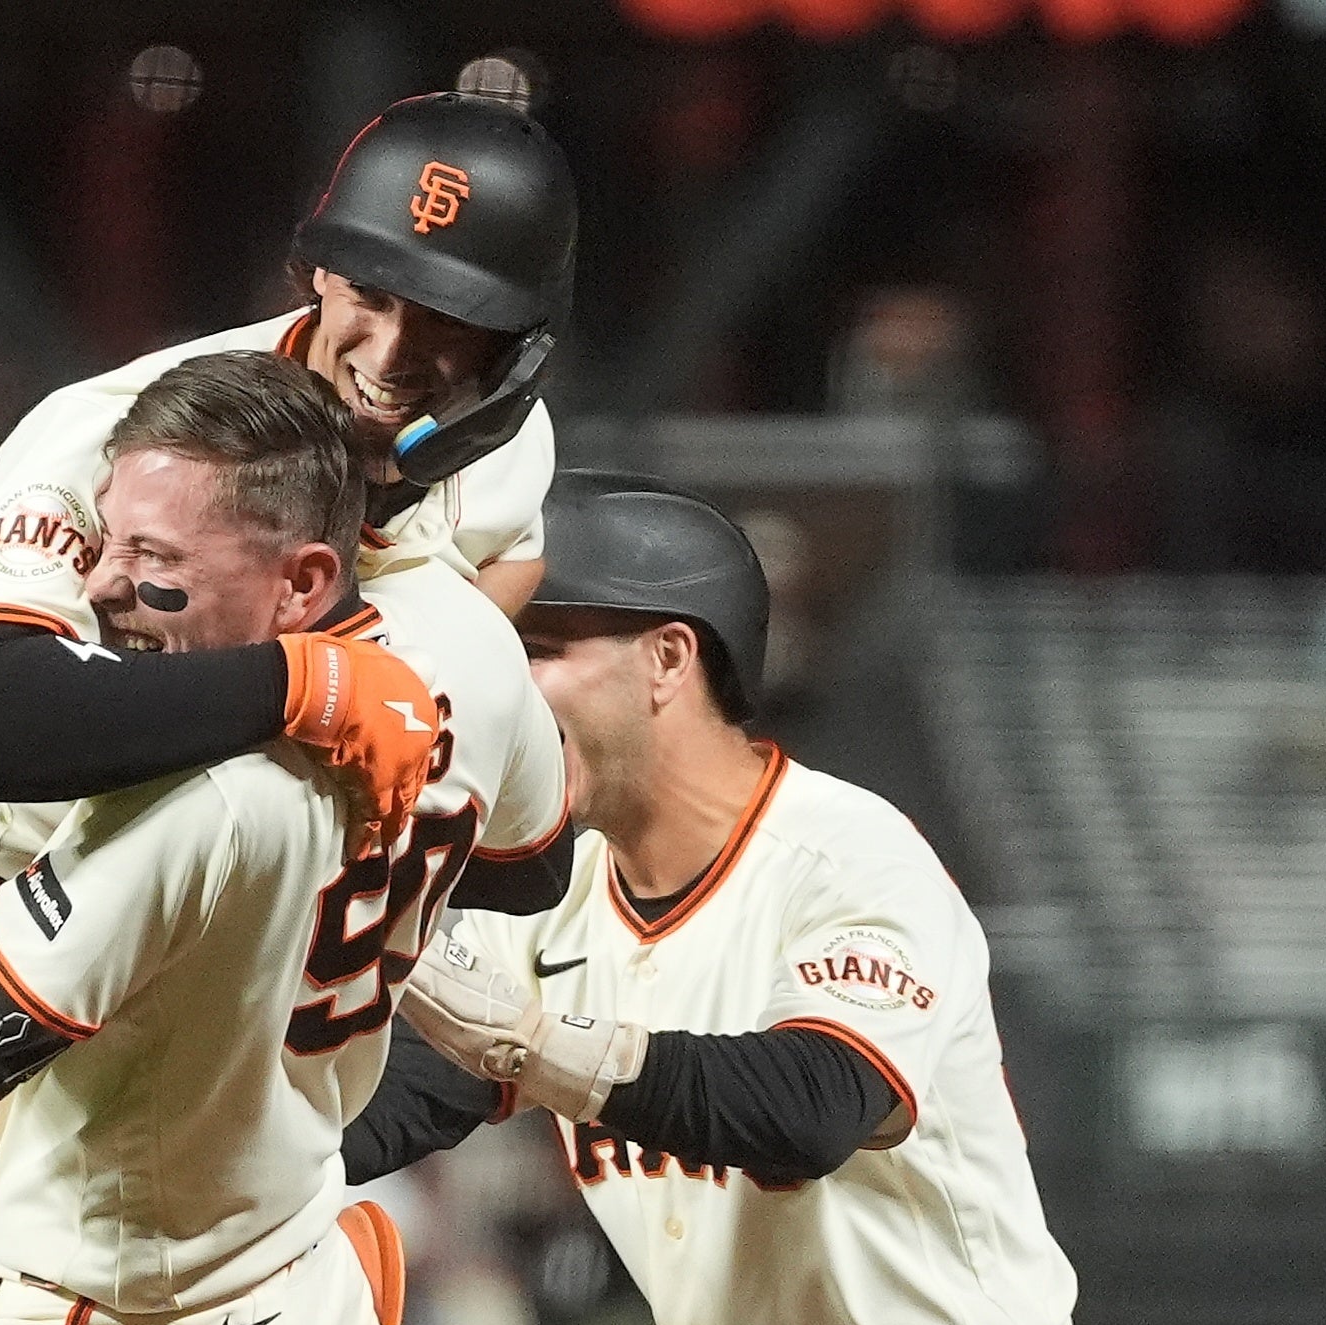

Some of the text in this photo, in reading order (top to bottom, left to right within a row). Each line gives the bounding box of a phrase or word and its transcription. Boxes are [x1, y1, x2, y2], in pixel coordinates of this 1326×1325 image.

[410, 160, 470, 236] SF
[0, 482, 87, 529] SAN FRANCISCO
[31, 559, 64, 577] CLUB
[26, 871, 64, 932] Airwallex
[823, 929, 913, 972] SAN FRANCISCO
[797, 955, 935, 1011] GIANTS
